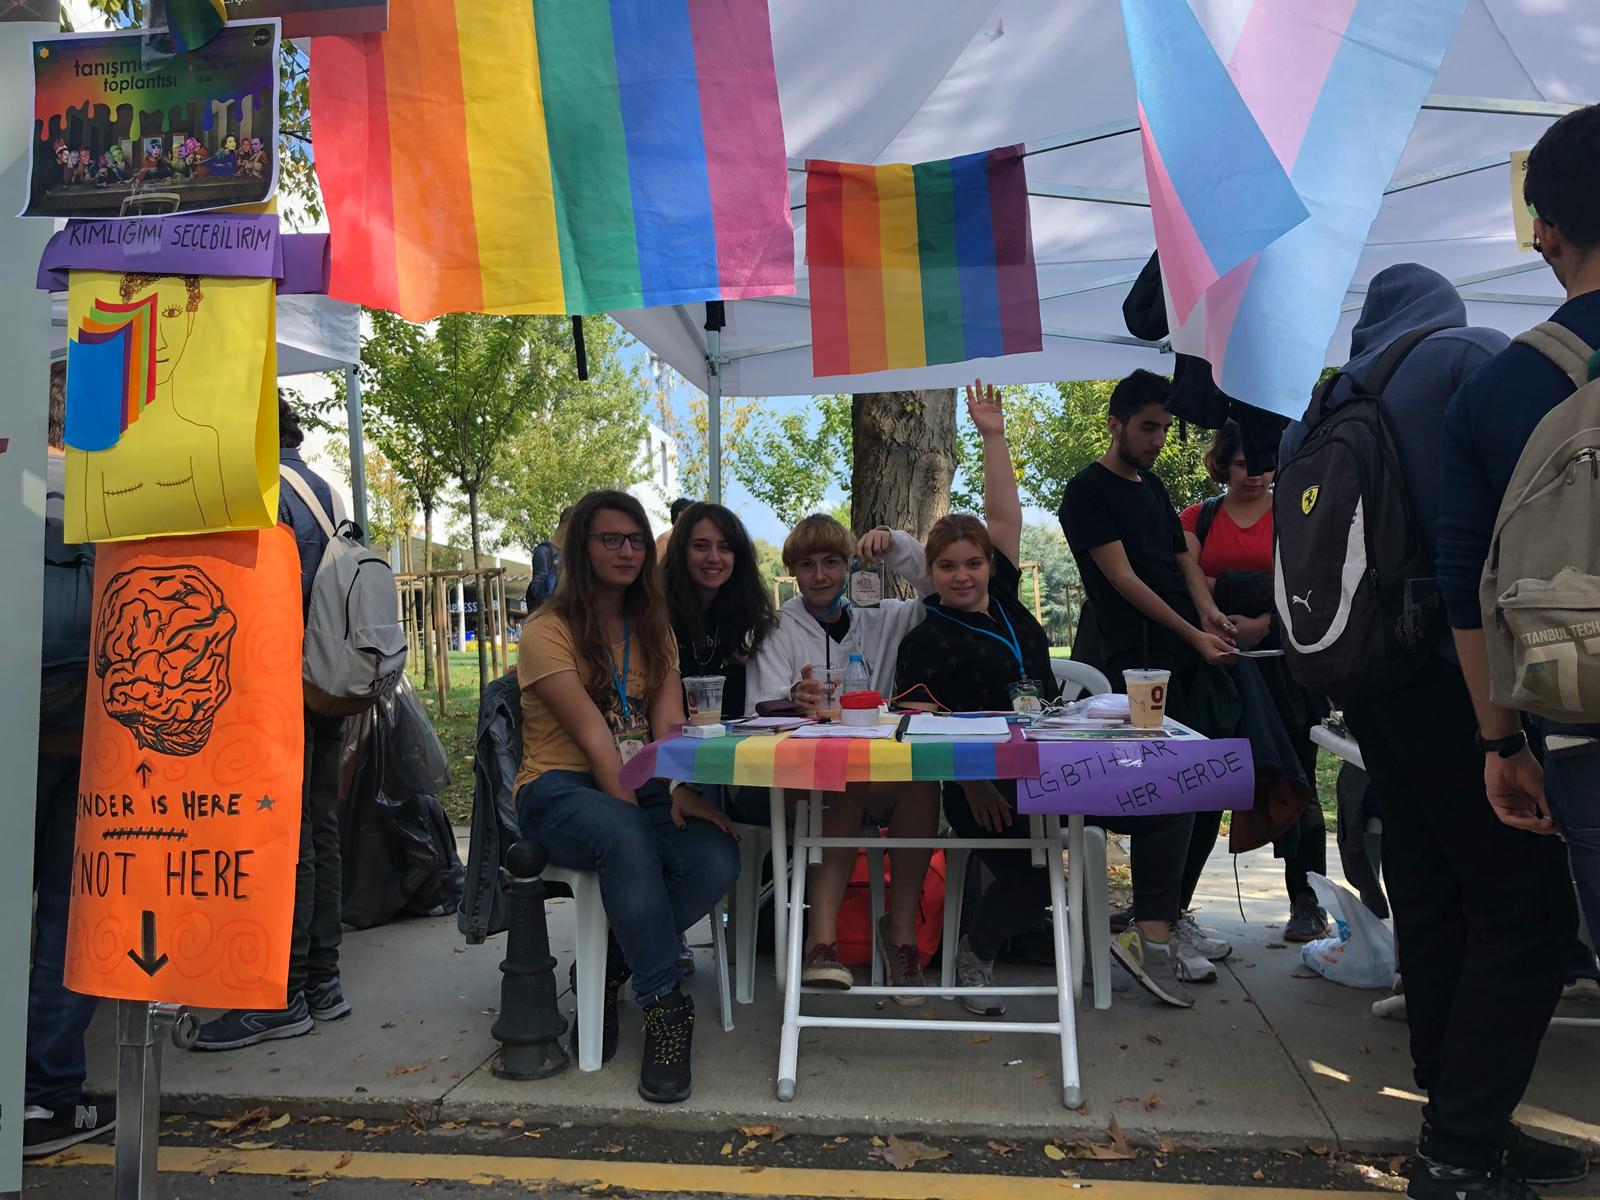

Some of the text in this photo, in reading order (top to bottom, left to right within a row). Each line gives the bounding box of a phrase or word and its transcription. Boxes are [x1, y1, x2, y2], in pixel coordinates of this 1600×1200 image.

[103, 74, 177, 95] toplantısı
[1523, 628, 1570, 645] TANBUL
[1116, 752, 1243, 813] HER YERDE
[151, 794, 169, 815] IS
[182, 790, 243, 821] HERE
[166, 849, 256, 901] HERE
